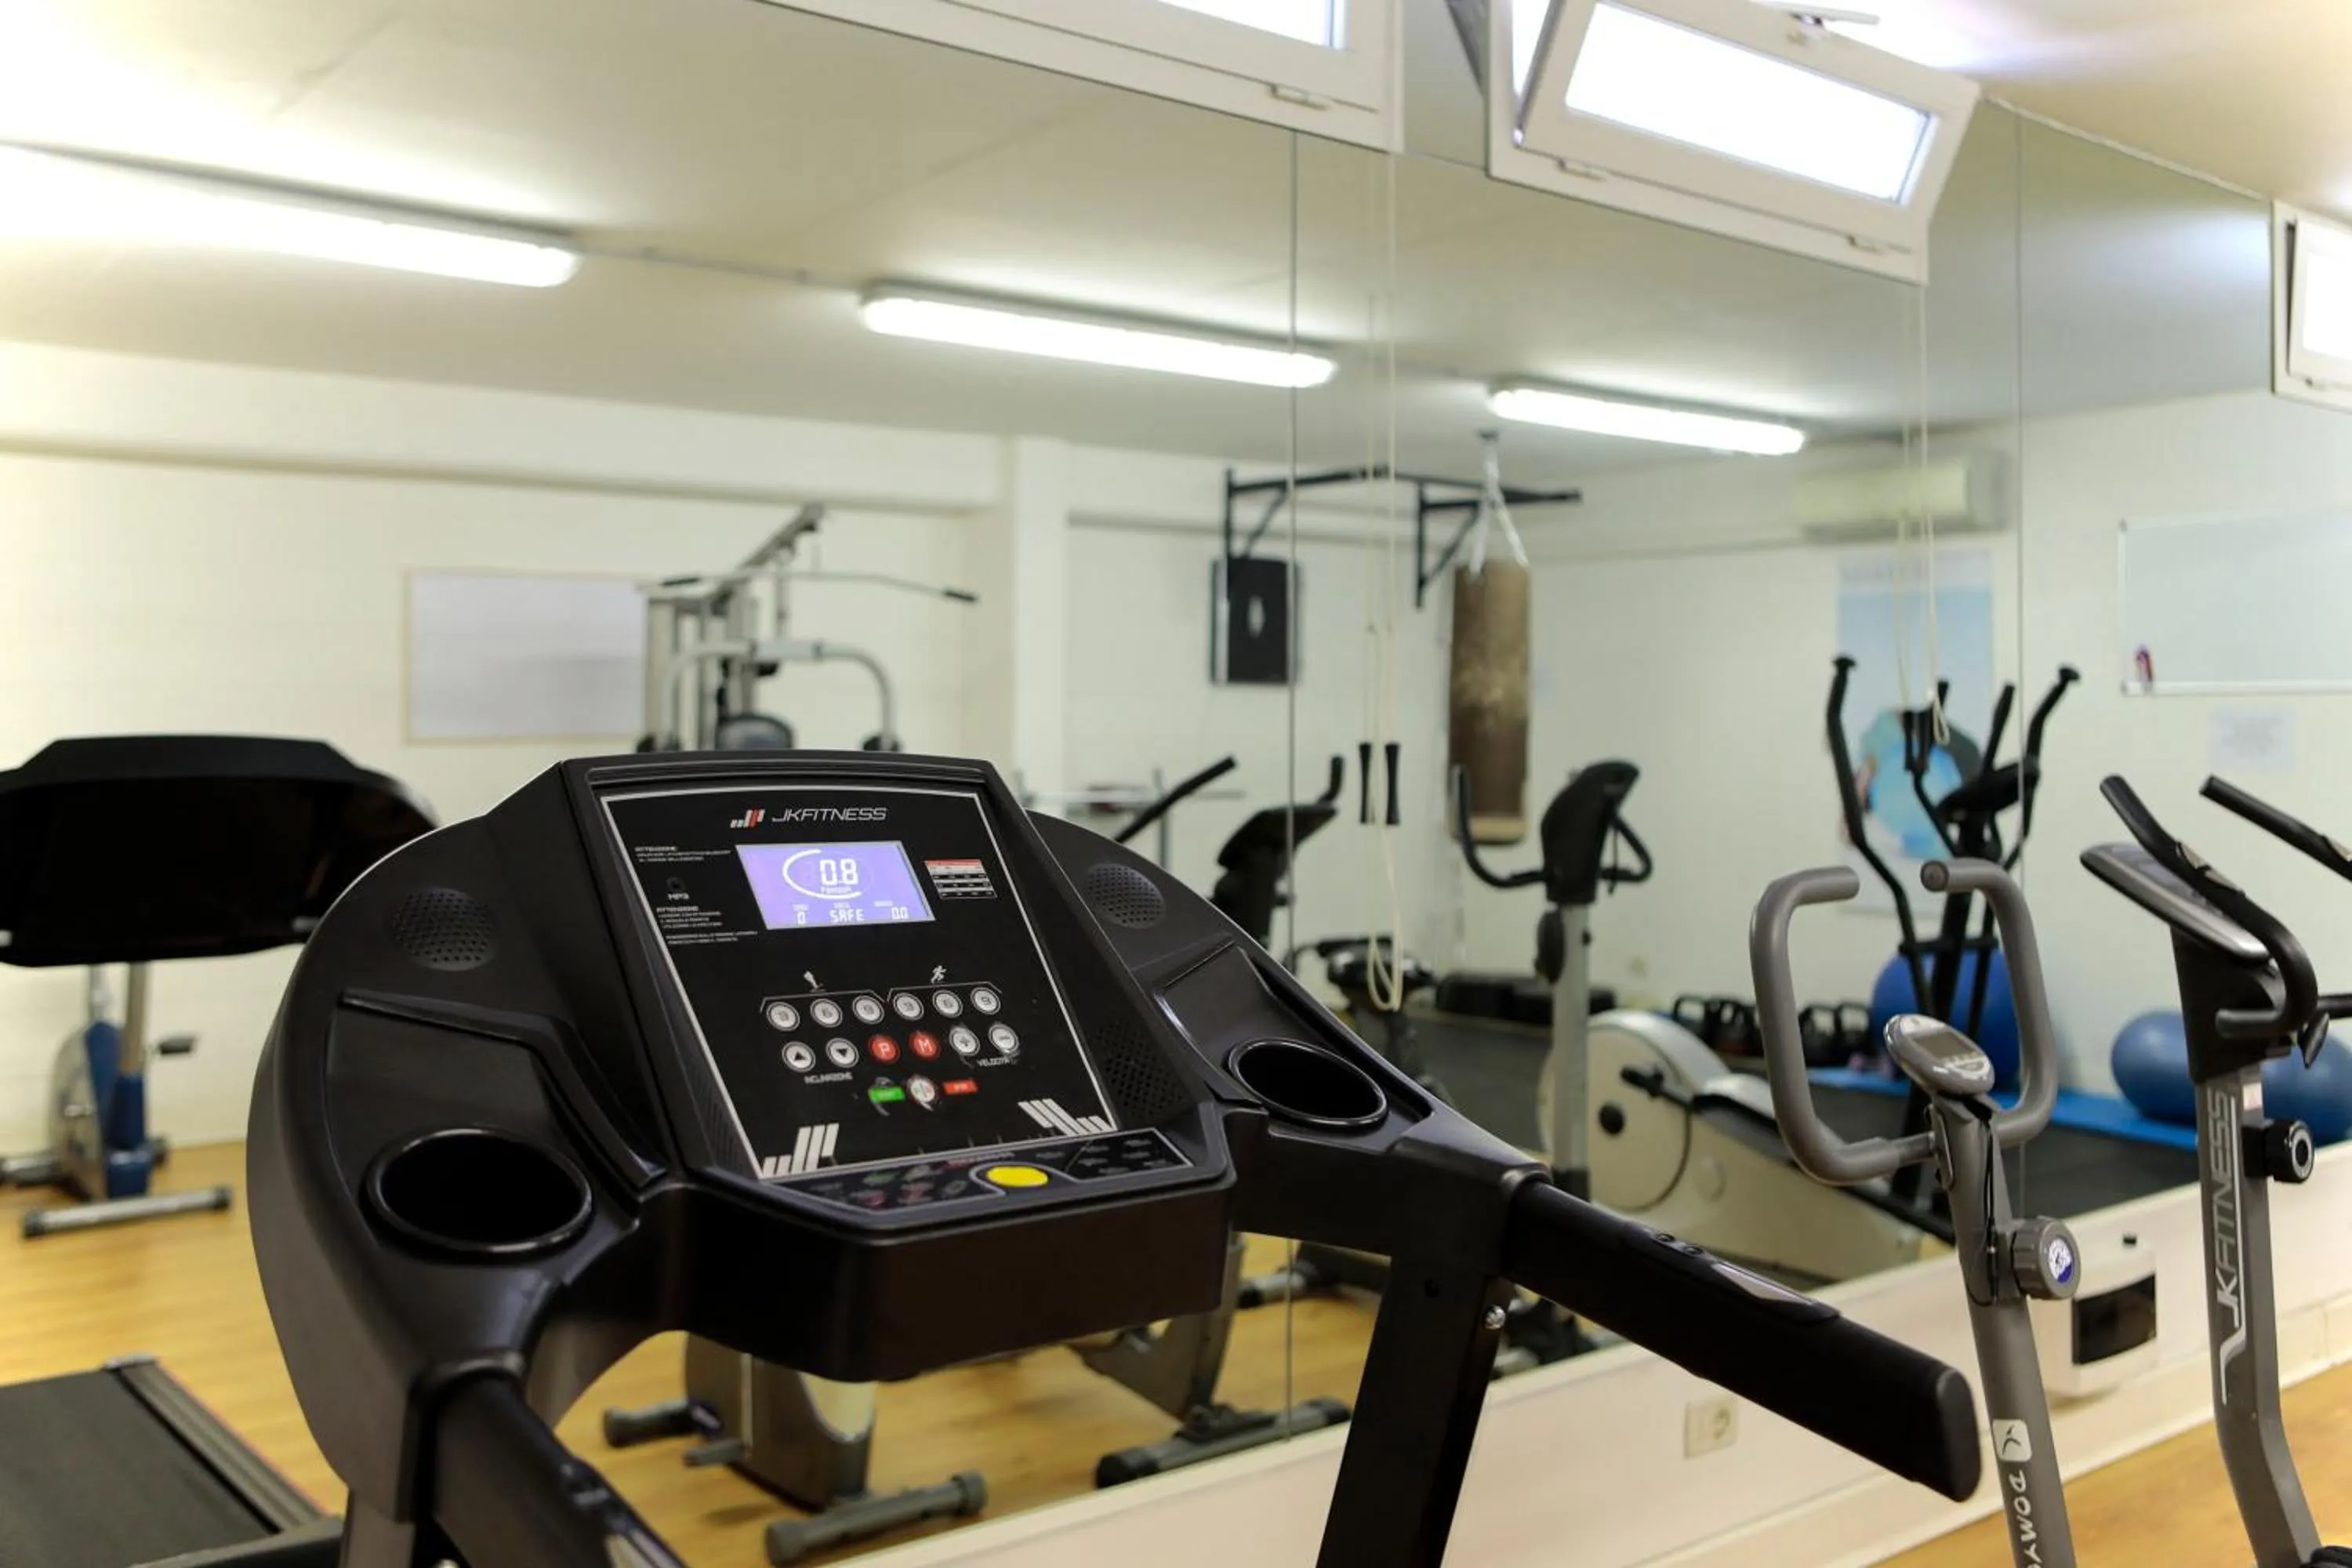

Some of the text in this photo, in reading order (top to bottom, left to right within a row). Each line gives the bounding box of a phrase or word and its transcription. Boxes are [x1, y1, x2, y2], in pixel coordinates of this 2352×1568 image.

[771, 807, 887, 823] JKFITNESS
[829, 908, 866, 924] SAFE
[2207, 1087, 2240, 1328] JKFITNESS
[2008, 1469, 2042, 1568] DOMY
